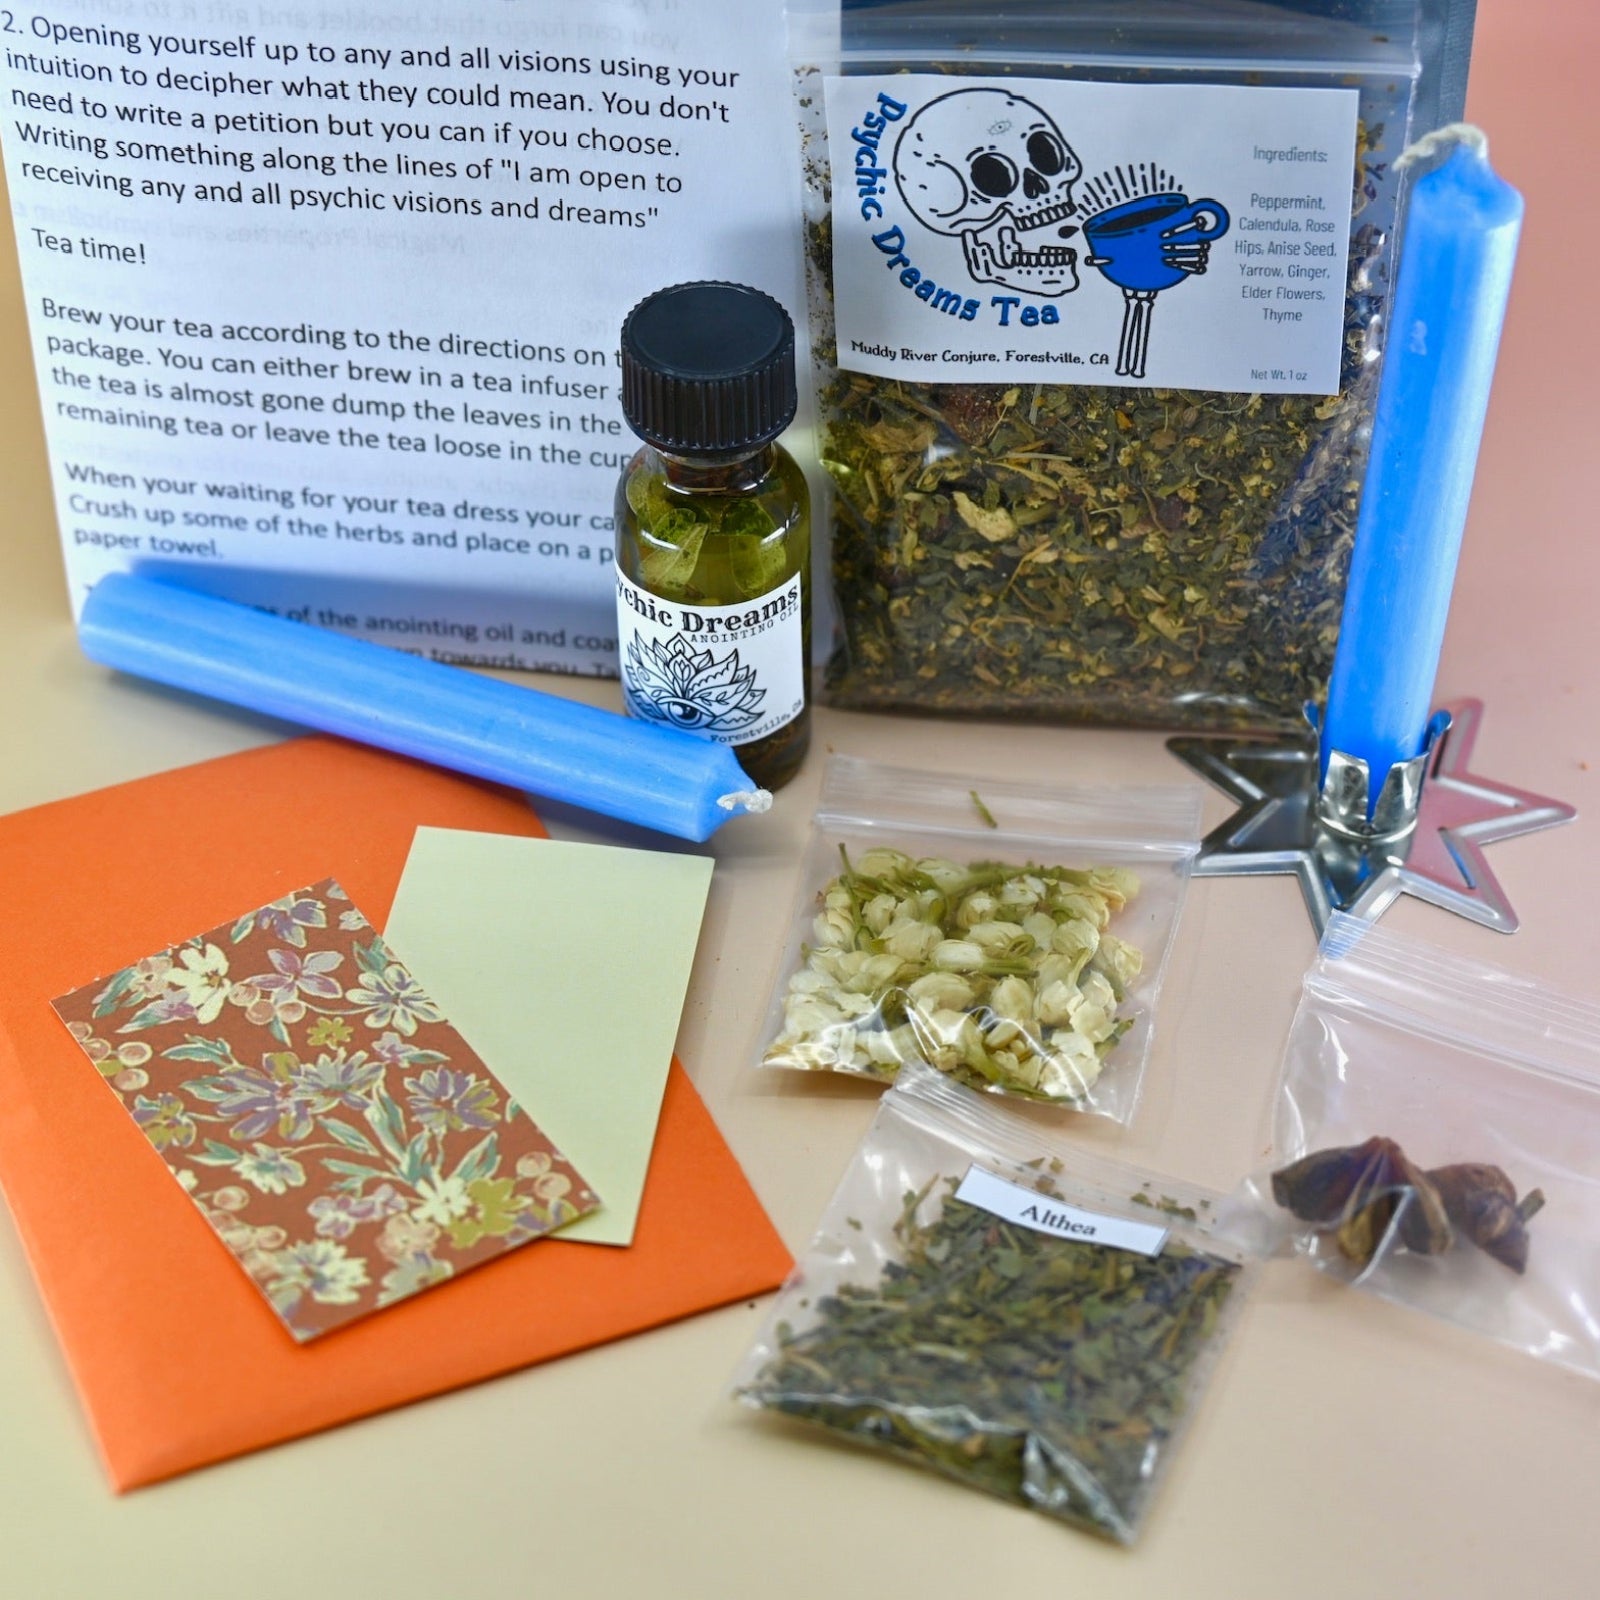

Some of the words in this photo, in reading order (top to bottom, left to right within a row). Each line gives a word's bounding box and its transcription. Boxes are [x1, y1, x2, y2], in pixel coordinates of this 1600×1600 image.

[1, 10, 23, 34] 2.
[31, 16, 141, 54] Opening
[148, 35, 255, 58] yourself
[265, 44, 298, 65] up
[307, 43, 335, 62] to
[345, 48, 391, 69] any
[401, 46, 450, 67] and
[461, 47, 489, 68] all
[499, 50, 591, 73] visions
[601, 57, 670, 85] using
[678, 68, 739, 87] your
[6, 48, 112, 82] intuition
[120, 66, 147, 86] to
[157, 67, 273, 97] decipher
[282, 76, 350, 100] what
[358, 79, 417, 108] they
[427, 83, 499, 107] could
[510, 91, 592, 112] mean.
[602, 91, 649, 115] You
[660, 95, 729, 123] don't
[12, 89, 73, 114] need
[80, 97, 107, 118] to
[115, 104, 181, 126] write
[191, 113, 204, 128] a
[215, 112, 318, 134] petition
[328, 114, 373, 137] but
[381, 123, 429, 142] you
[440, 126, 484, 142] can
[495, 122, 511, 143] if
[519, 130, 567, 151] you
[578, 128, 679, 156] choose.
[15, 121, 108, 159] Writing
[116, 141, 255, 172] something
[263, 147, 336, 176] along
[343, 152, 387, 173] the
[397, 154, 457, 177] lines
[466, 158, 493, 179] of
[530, 167, 569, 184] am
[580, 171, 645, 192] open
[656, 173, 682, 193] to
[850, 92, 907, 222] Psychic
[22, 163, 134, 197] receiving
[142, 180, 185, 203] any
[195, 181, 242, 202] and
[252, 182, 280, 204] all
[290, 186, 385, 211] psychic
[393, 191, 482, 215] visions
[491, 197, 538, 219] and
[549, 199, 657, 228] dreams"
[32, 228, 72, 254] Tea
[80, 238, 145, 264] time!
[1267, 241, 1301, 256] Anise
[1306, 219, 1335, 233] Rose
[871, 225, 980, 322] Dreams
[1242, 285, 1272, 298] Elder
[42, 298, 102, 325] Brew
[109, 314, 165, 333] your
[173, 318, 213, 338] tea
[222, 323, 347, 350] according
[354, 329, 380, 348] to
[388, 330, 430, 351] the
[439, 333, 565, 363] directions
[574, 349, 605, 366] on
[991, 297, 1060, 326] Tea
[1263, 308, 1302, 324] Thyme
[47, 336, 151, 367] package.
[158, 348, 203, 370] You
[212, 358, 255, 374] can
[263, 357, 339, 378] either
[348, 360, 411, 384] brew
[420, 366, 441, 387] in
[451, 374, 463, 388] a
[473, 372, 512, 392] tea
[522, 374, 609, 400] infuser
[851, 340, 897, 361] Muddy
[900, 348, 938, 361] River
[1090, 353, 1109, 365] CA
[1251, 369, 1267, 380] Net
[52, 366, 91, 389] the
[98, 375, 136, 395] tea
[144, 379, 163, 399] is
[170, 382, 254, 408] almost
[262, 393, 324, 413] gone
[332, 393, 405, 422] dump
[413, 400, 455, 422] the
[464, 402, 541, 429] leaves
[550, 411, 570, 431] in
[580, 413, 621, 435] the
[57, 402, 178, 436] remaining
[184, 417, 223, 436] tea
[231, 424, 257, 439] or
[265, 421, 330, 445] leave
[338, 427, 379, 448] the
[387, 433, 426, 452] tea
[435, 434, 501, 459] loose
[510, 440, 531, 461] in
[540, 443, 581, 465] the
[65, 462, 136, 489] When
[142, 477, 197, 495] your
[205, 483, 295, 509] waiting
[301, 487, 335, 508] for
[343, 496, 398, 514] your
[406, 498, 445, 517] tea
[453, 500, 519, 523] dress
[526, 511, 582, 528] your
[69, 494, 137, 520] Crush
[144, 509, 175, 527] up
[182, 512, 248, 531] some
[255, 515, 280, 533] of
[287, 518, 328, 538] the
[335, 520, 404, 545] herbs
[412, 530, 458, 548] and
[466, 532, 530, 554] place
[538, 541, 569, 557] on
[578, 545, 591, 560] a
[74, 528, 141, 549] paper
[149, 535, 222, 558] towel.
[318, 606, 358, 630] the
[364, 615, 478, 644] anointing
[485, 621, 514, 642] oil
[521, 627, 566, 649] and
[573, 633, 619, 653] coa
[680, 585, 798, 634] Dreams
[691, 618, 774, 643] ANOINTING
[779, 602, 799, 621] OIL
[1020, 1205, 1097, 1236] Althea
